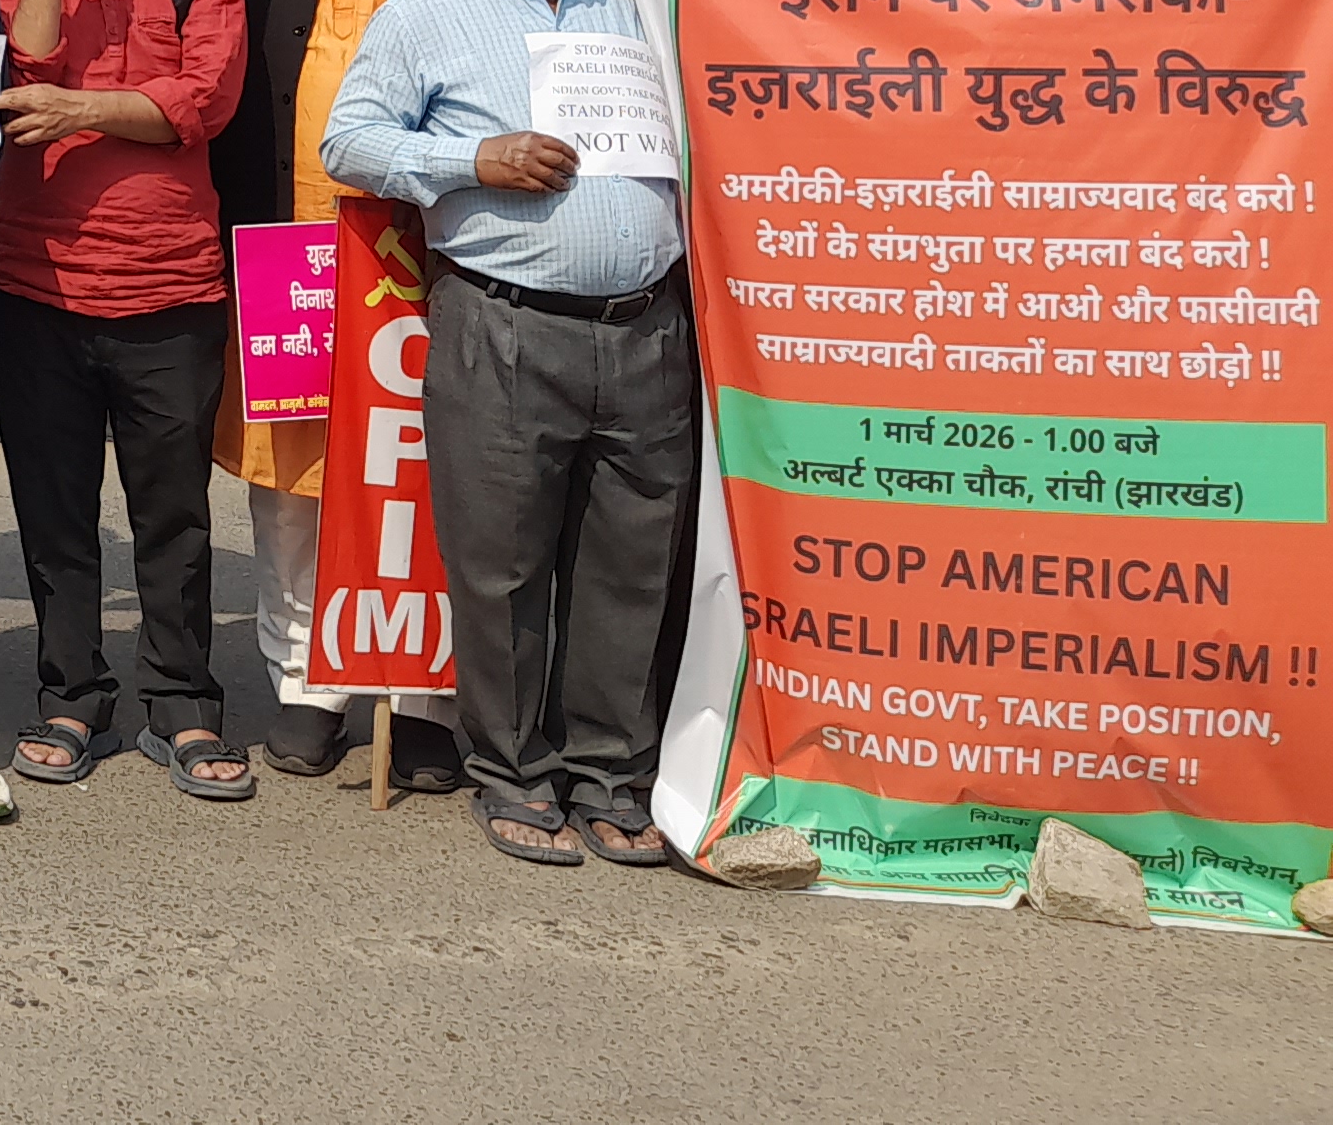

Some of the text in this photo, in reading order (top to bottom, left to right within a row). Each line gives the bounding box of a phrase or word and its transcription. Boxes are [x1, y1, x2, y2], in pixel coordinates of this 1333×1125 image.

[553, 62, 606, 74] ISRAELI
[574, 44, 606, 56] STOP
[557, 104, 647, 119] STAND FOR
[627, 87, 648, 100] TAKE
[705, 48, 1309, 132] इज़राईली युद्ध के विरुद्ध
[575, 132, 630, 153] NOT
[720, 167, 1295, 212] अमरीकी-इज़राईली साम्राज्यवाद बंद करो
[727, 279, 1319, 328] भारत सरकार होश में आओ और फासीवादी
[249, 335, 276, 357] बम
[756, 332, 1251, 388] साम्राज्यवादी ताकतों का साथ छोड़ो
[859, 417, 1160, 456] 1 मार्च 2026 1.00 बजे
[783, 457, 1244, 513] अल्बर्ट एक्का चौक, रांची (झारखंड)
[792, 533, 1230, 606] STOP AMERICAN
[920, 621, 1269, 684] IMPERIALISM
[755, 658, 1282, 747] INDIAN GOVT, TAKE POSITION,
[821, 726, 1168, 785] STAND WITH PEACE
